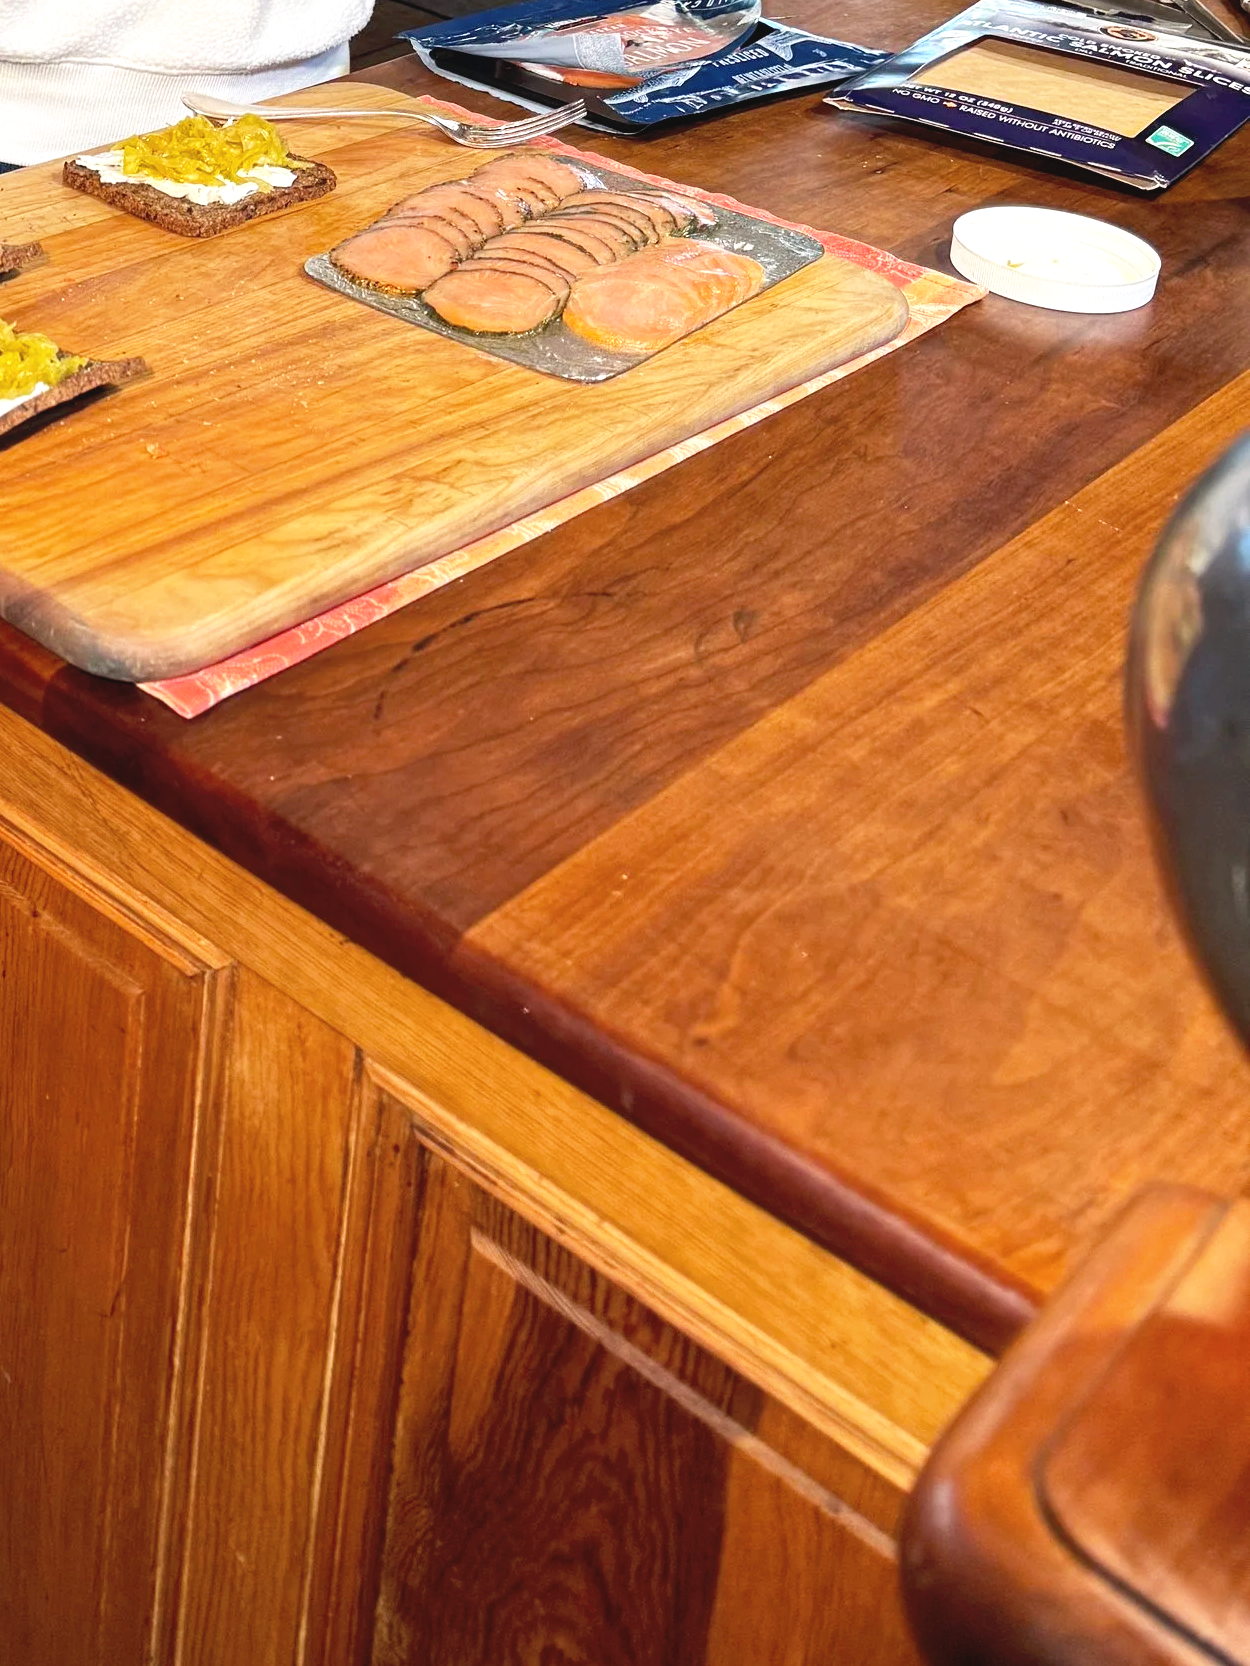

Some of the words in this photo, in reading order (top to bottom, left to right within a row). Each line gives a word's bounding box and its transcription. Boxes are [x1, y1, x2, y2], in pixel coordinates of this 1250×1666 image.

[955, 20, 1064, 43] ATLANTIC
[1069, 40, 1173, 69] SALMON
[1178, 65, 1250, 95] SLICES
[892, 88, 911, 96] NO
[912, 93, 940, 104] GMO
[958, 105, 996, 120] RAISED
[999, 115, 1049, 133] WITHOUT
[1049, 128, 1117, 150] ANTIBIOTICS
[924, 87, 943, 95] WT
[959, 95, 976, 103] OZ
